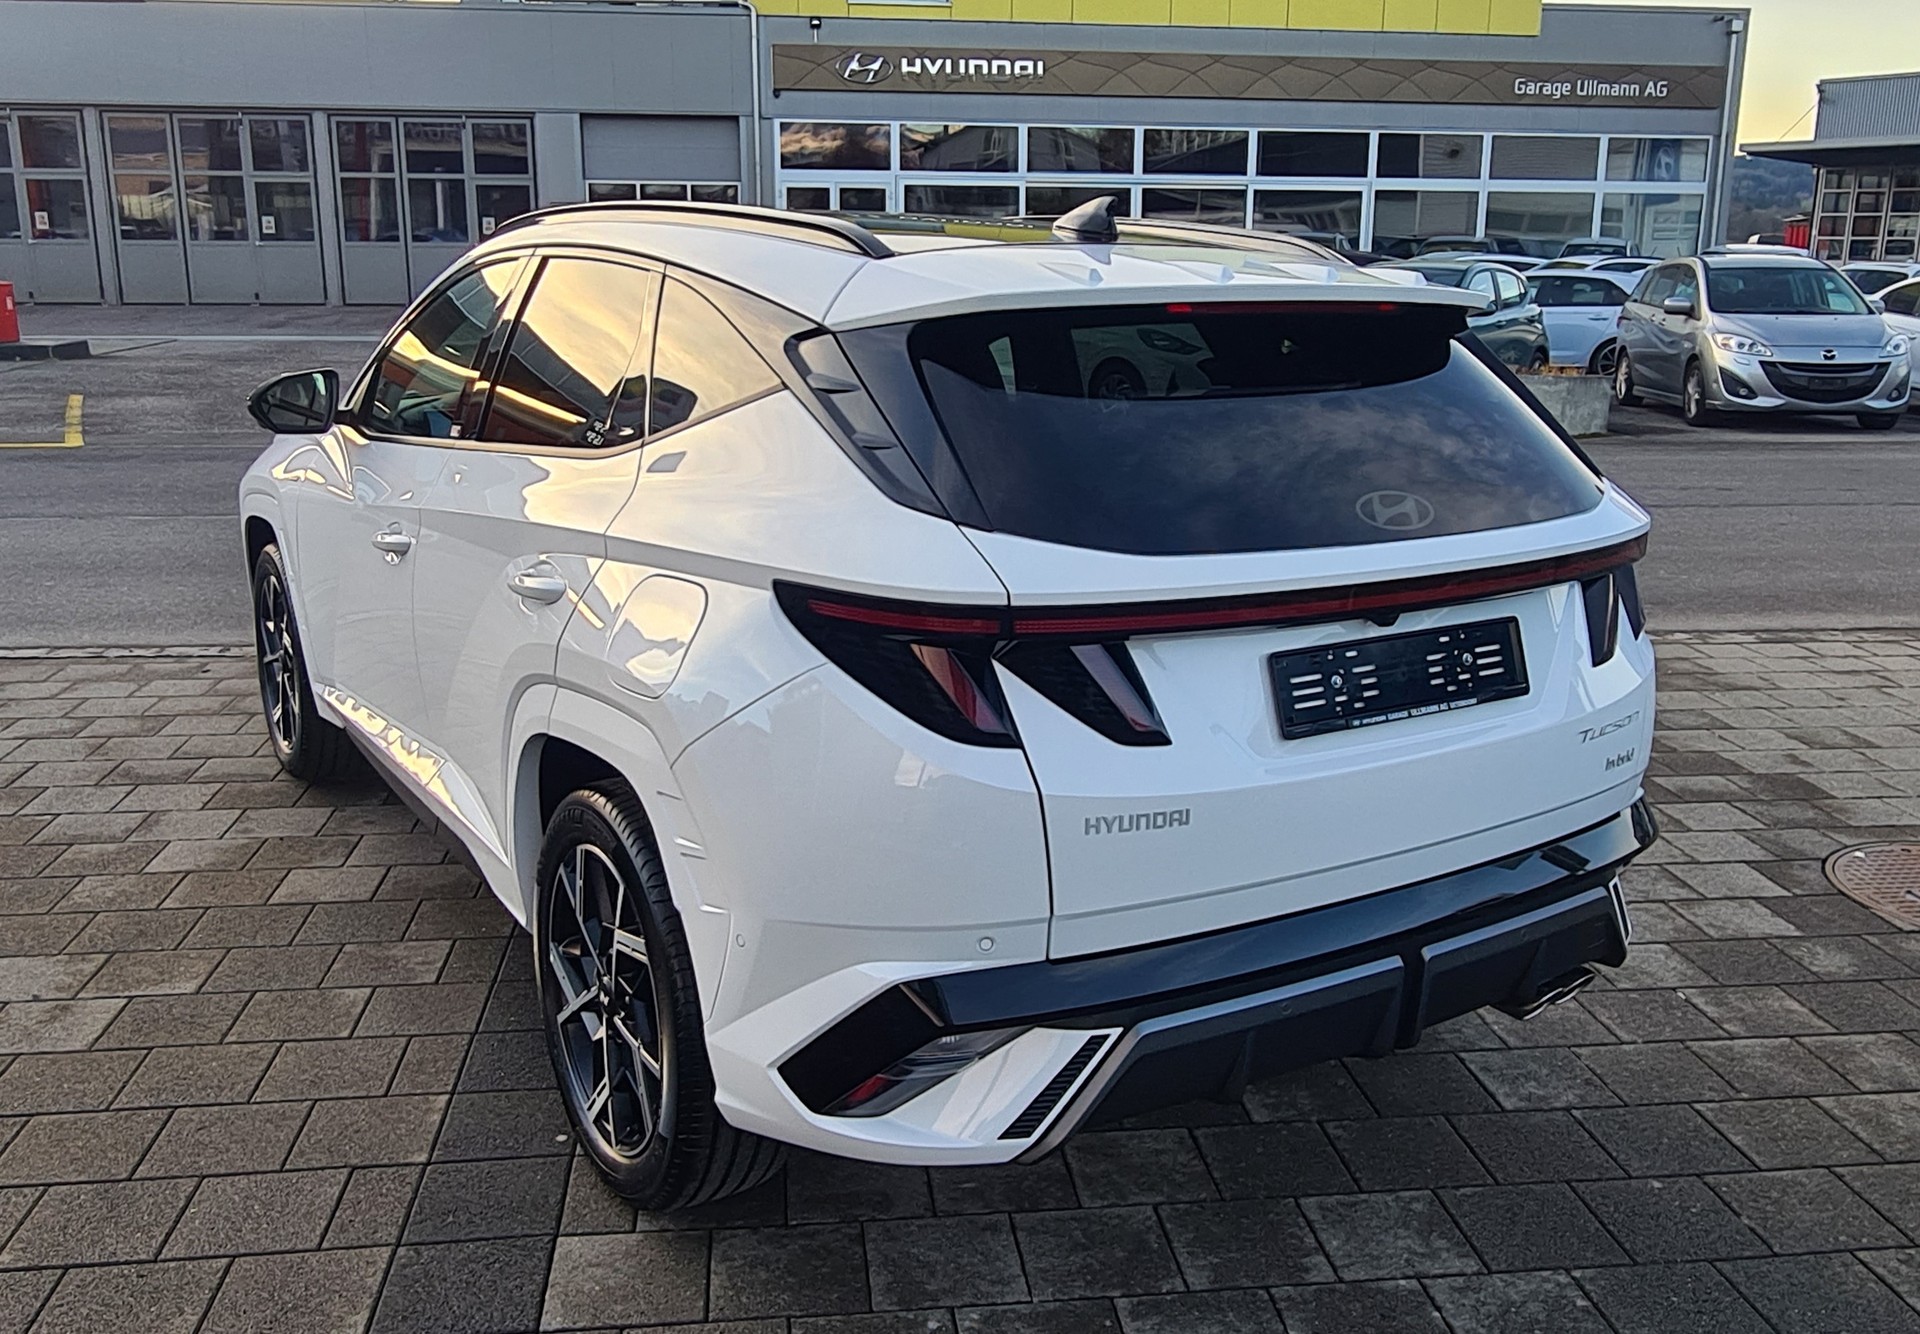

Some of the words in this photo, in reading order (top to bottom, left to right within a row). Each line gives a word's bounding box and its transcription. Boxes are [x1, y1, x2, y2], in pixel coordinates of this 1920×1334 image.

[901, 57, 1045, 82] HYUNDAI
[1514, 78, 1571, 99] Garage
[1576, 79, 1640, 97] Ullmann
[1644, 81, 1668, 97] AG
[1084, 808, 1191, 836] HYUNDAI
